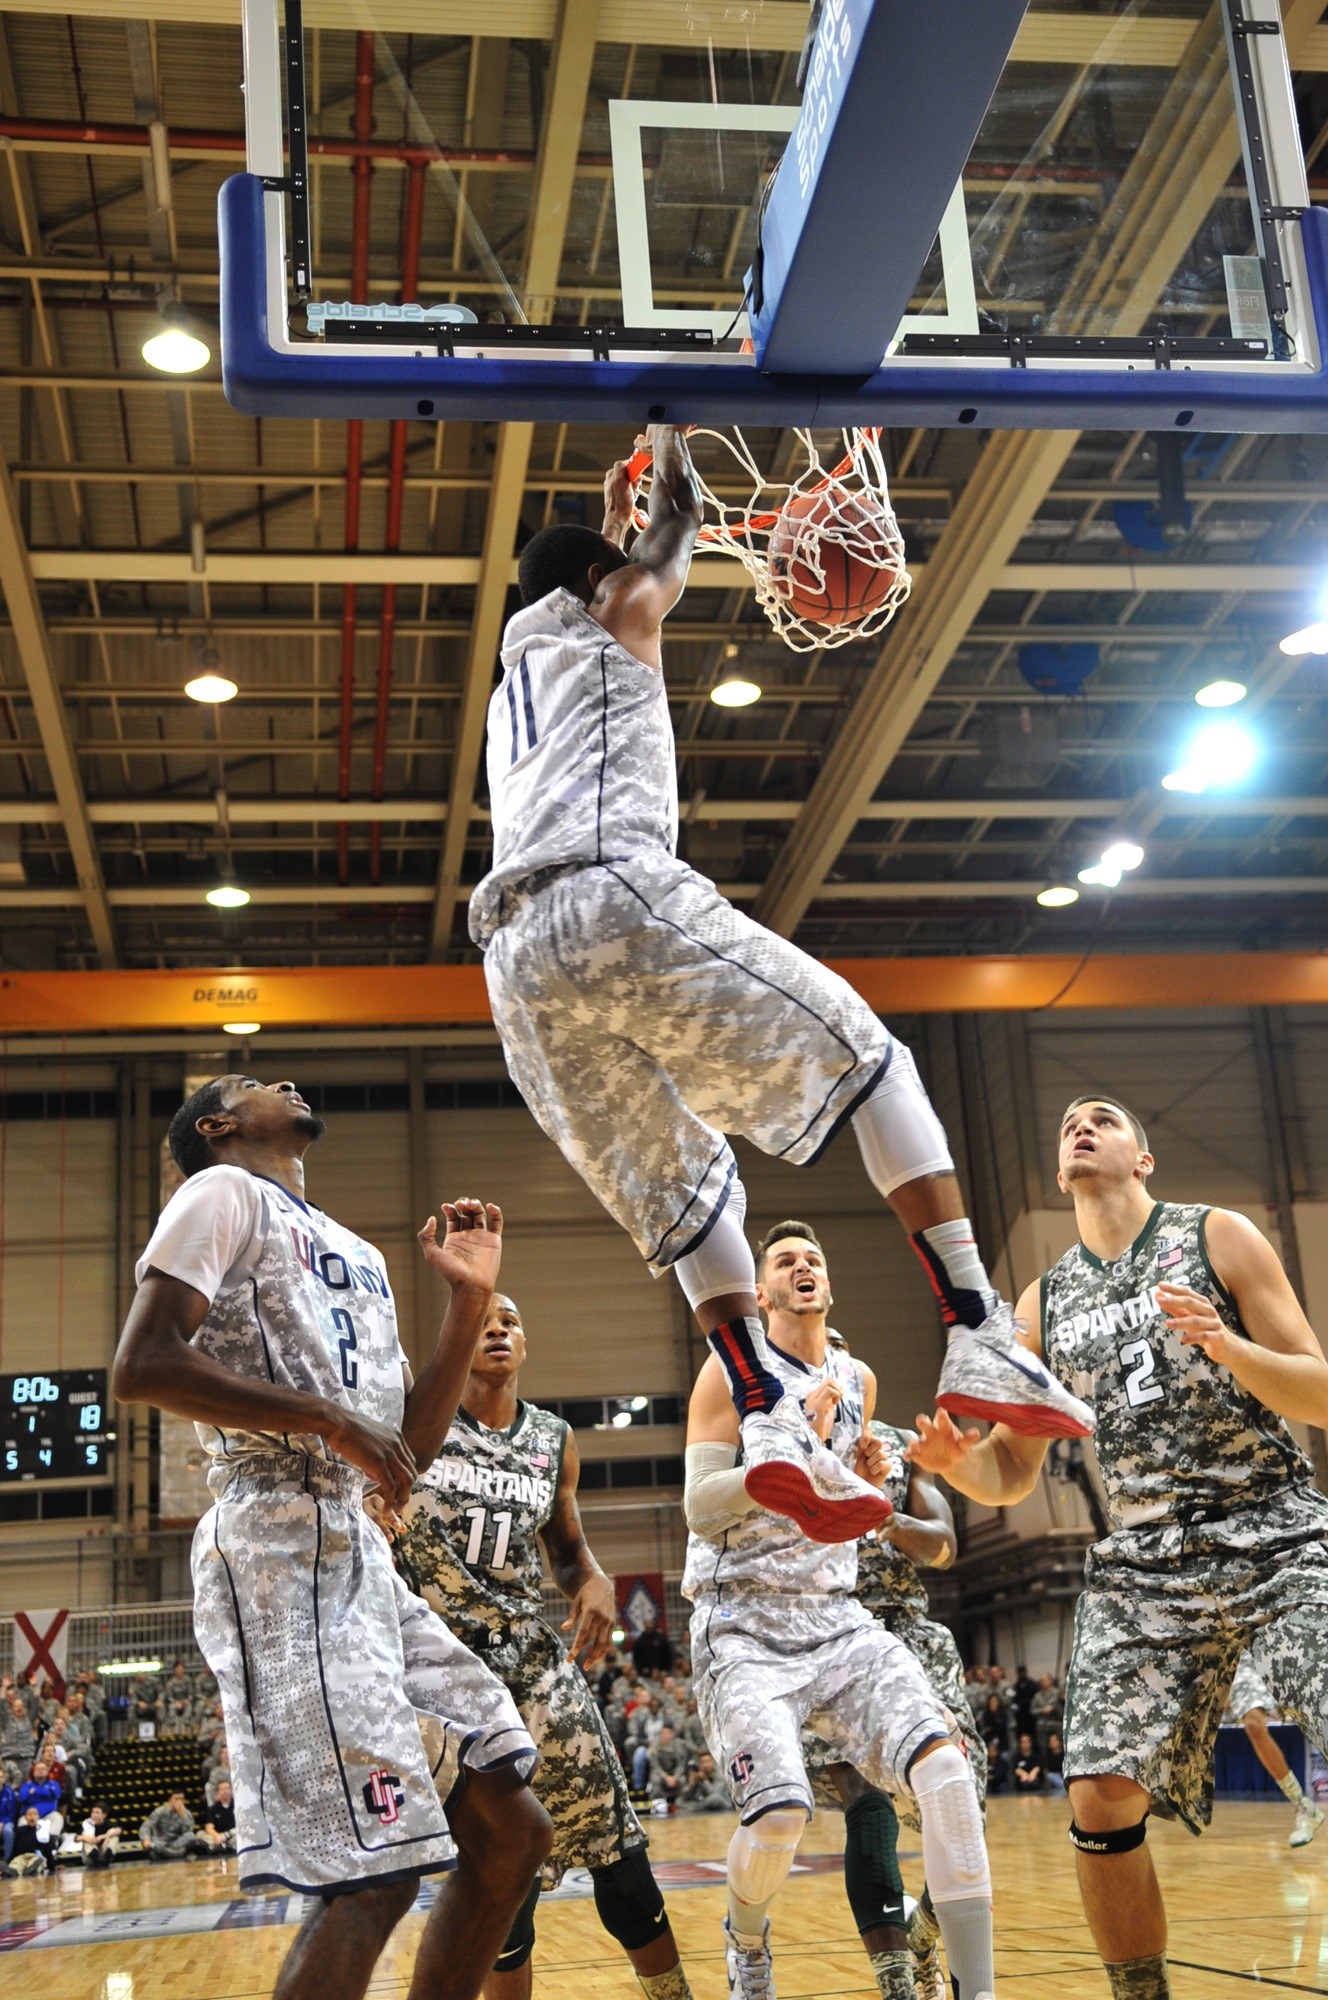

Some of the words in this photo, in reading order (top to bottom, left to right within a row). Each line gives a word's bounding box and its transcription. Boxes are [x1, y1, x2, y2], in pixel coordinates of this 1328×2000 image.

[192, 987, 259, 1002] DEMAG
[331, 1307, 358, 1390] 2
[13, 1377, 60, 1403] 8:06
[1118, 1337, 1166, 1408] 2
[80, 1404, 101, 1430] 18
[6, 1450, 19, 1470] 5
[39, 1449, 52, 1466] 4
[86, 1445, 99, 1465] 5
[424, 1458, 552, 1508] SPARTANS
[464, 1506, 513, 1570] 11
